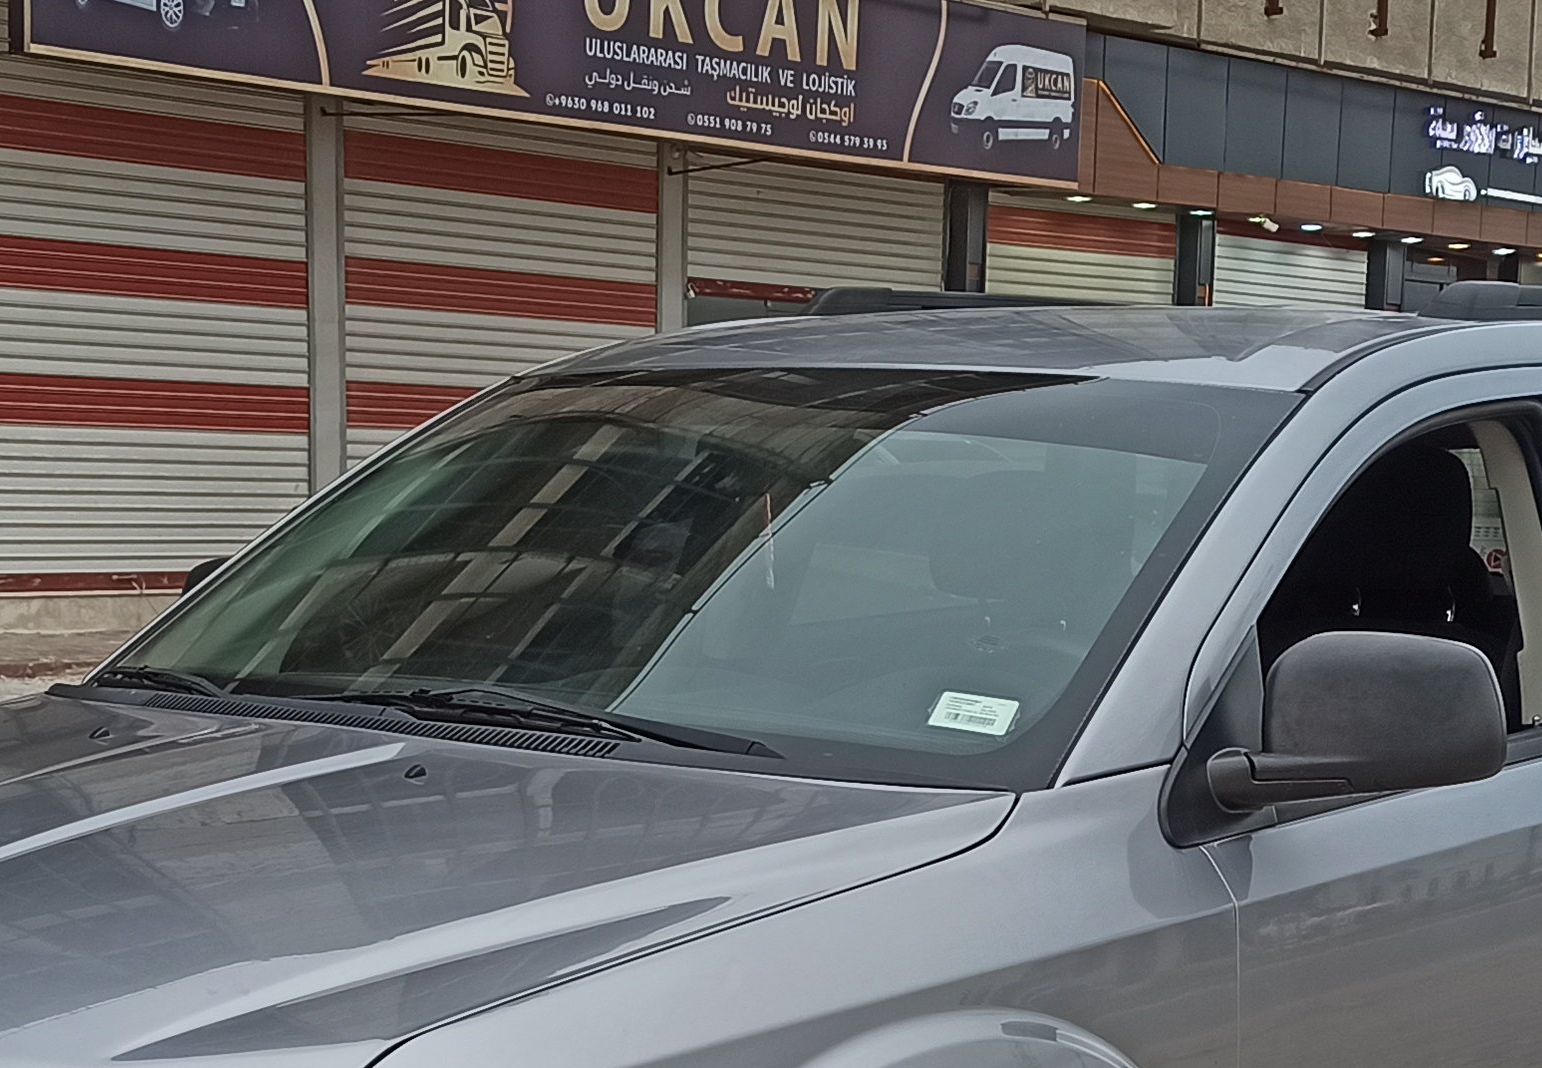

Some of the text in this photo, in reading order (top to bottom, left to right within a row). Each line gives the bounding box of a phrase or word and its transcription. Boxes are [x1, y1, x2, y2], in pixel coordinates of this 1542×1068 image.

[585, 37, 856, 97] ULUSLARARASI TAŞMACILIK VE LOJİSTİK
[585, 68, 691, 95] شحن ونقل دولي
[1037, 71, 1071, 92] UKCAN
[590, 100, 610, 112] 968
[613, 102, 632, 116] 011
[637, 106, 656, 119] 102
[696, 114, 772, 136] 0551 908 79 75
[817, 131, 841, 144] 0544
[844, 134, 860, 148] 579
